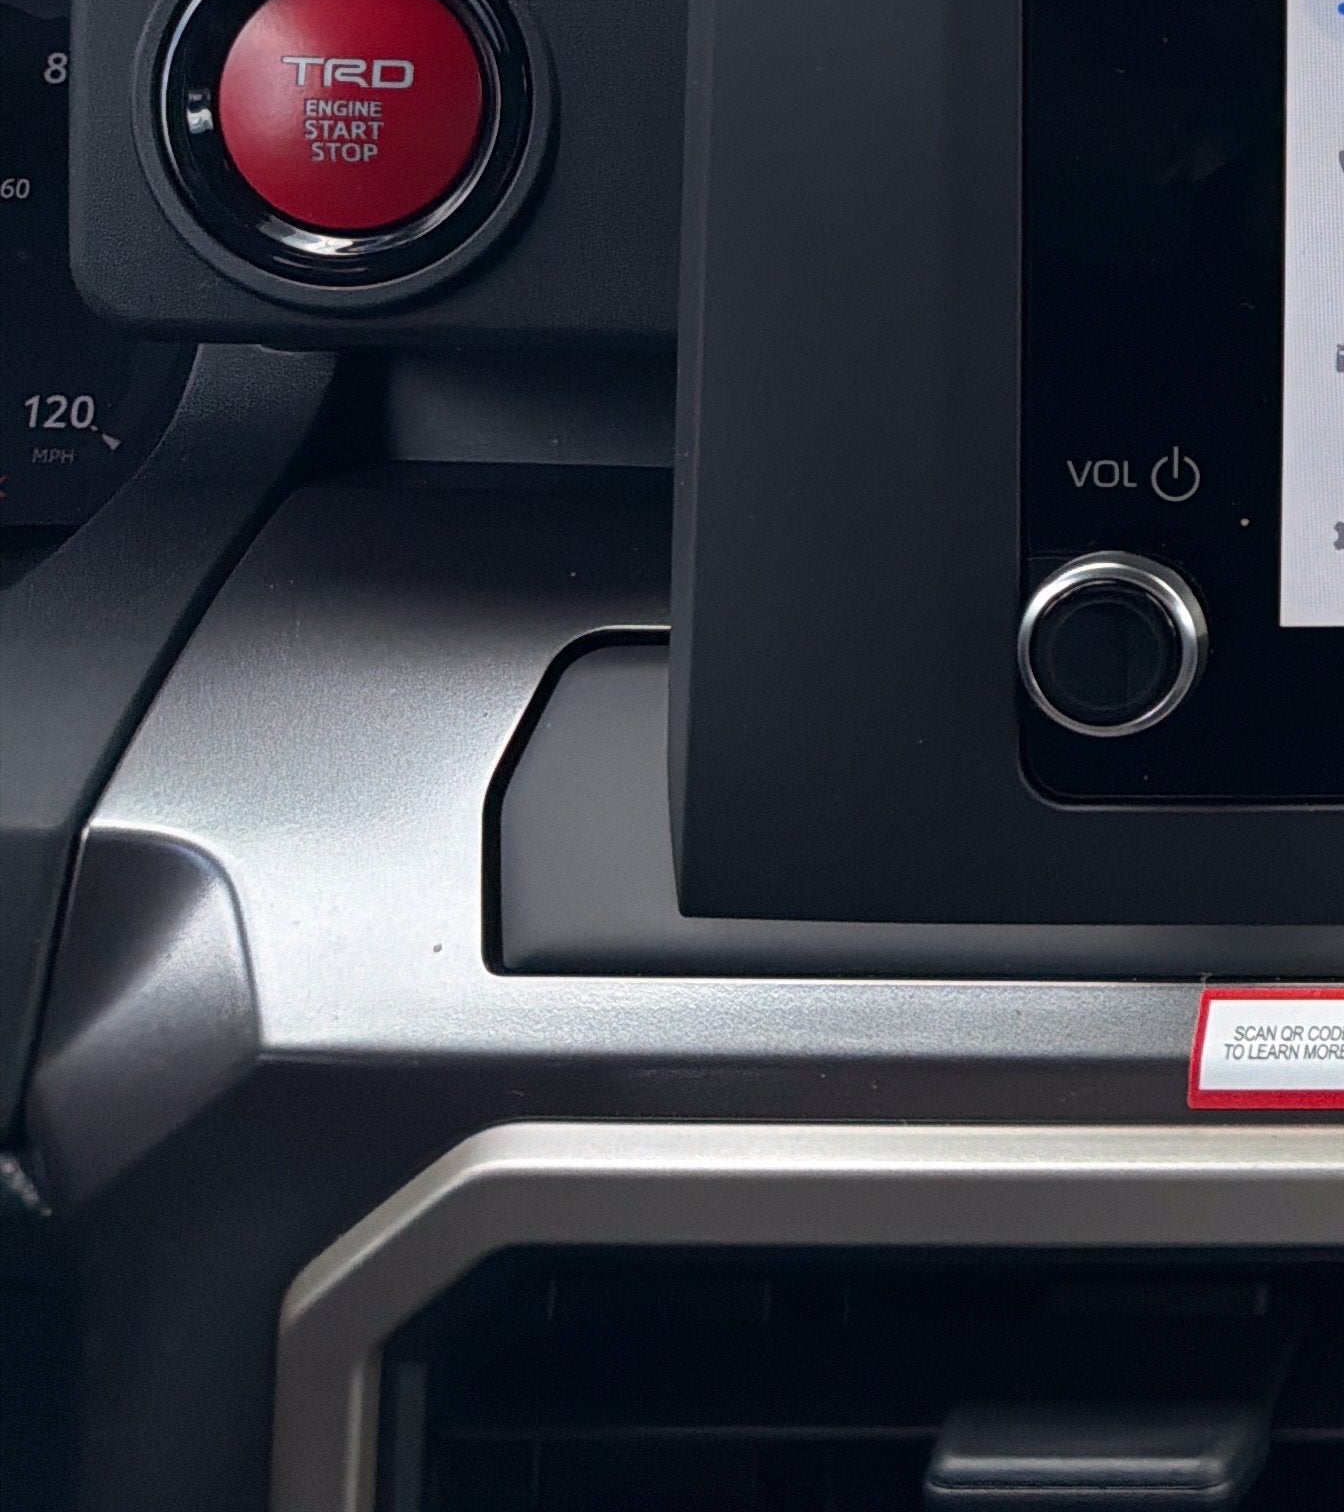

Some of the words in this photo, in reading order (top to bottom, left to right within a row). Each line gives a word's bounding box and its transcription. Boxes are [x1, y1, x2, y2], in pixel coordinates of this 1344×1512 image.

[281, 55, 416, 90] TRD
[304, 98, 383, 119] ENGINE
[303, 119, 385, 141] START
[310, 141, 380, 164] STOP
[24, 394, 95, 429] 120
[31, 448, 75, 464] MPH
[1066, 459, 1138, 489] VOL
[1234, 1025, 1278, 1042] SCAN
[1280, 1026, 1305, 1041] QR
[1224, 1044, 1246, 1060] TO
[1248, 1044, 1300, 1060] LEARN
